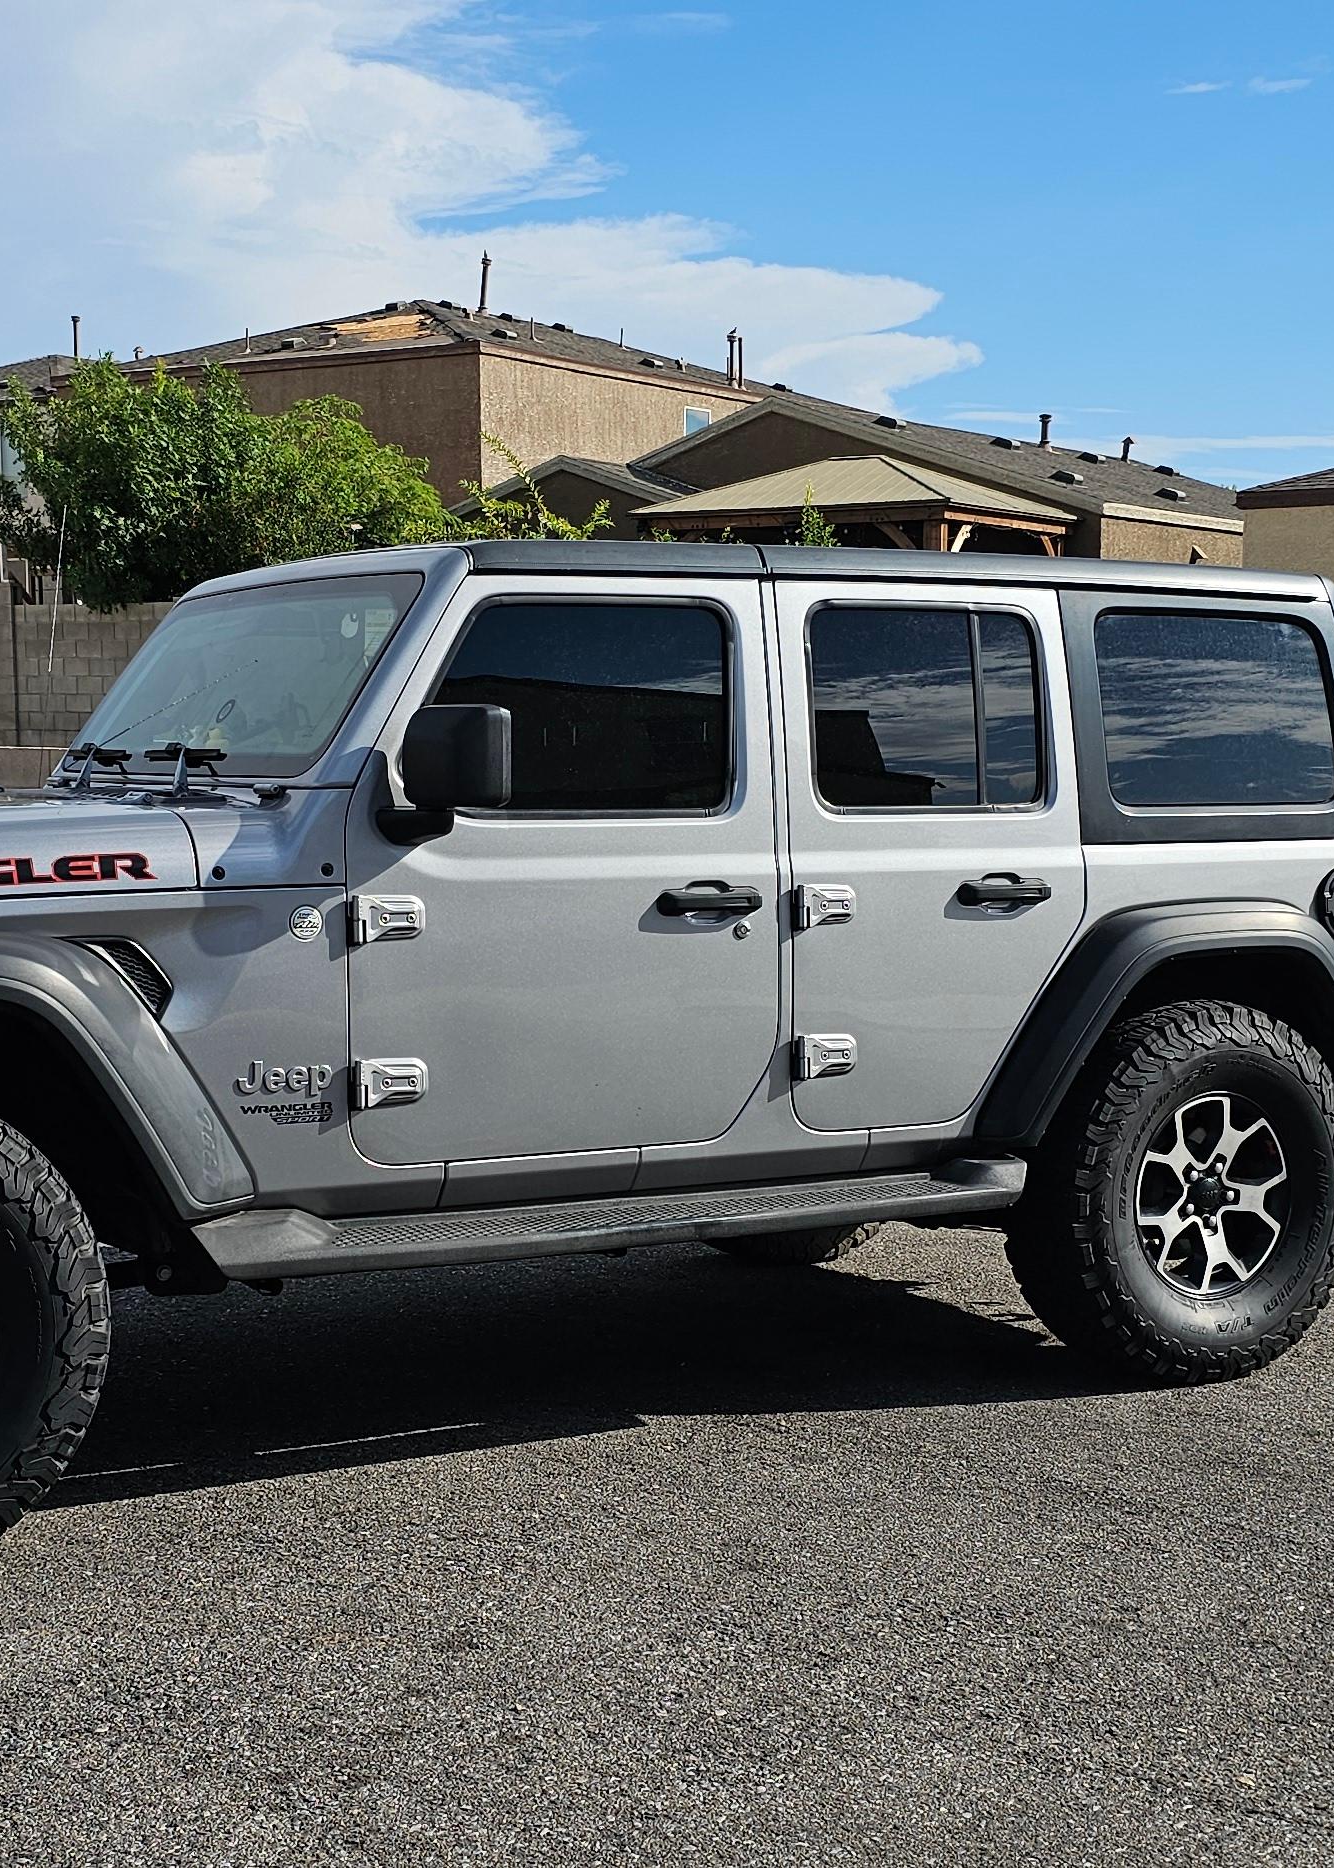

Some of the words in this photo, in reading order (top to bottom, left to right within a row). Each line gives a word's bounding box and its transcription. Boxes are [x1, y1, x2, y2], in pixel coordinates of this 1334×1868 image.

[236, 1060, 333, 1096] Jeep
[240, 1101, 333, 1115] WRANGLER
[276, 1115, 329, 1124] SPORT
[1214, 1315, 1256, 1336] T/A
